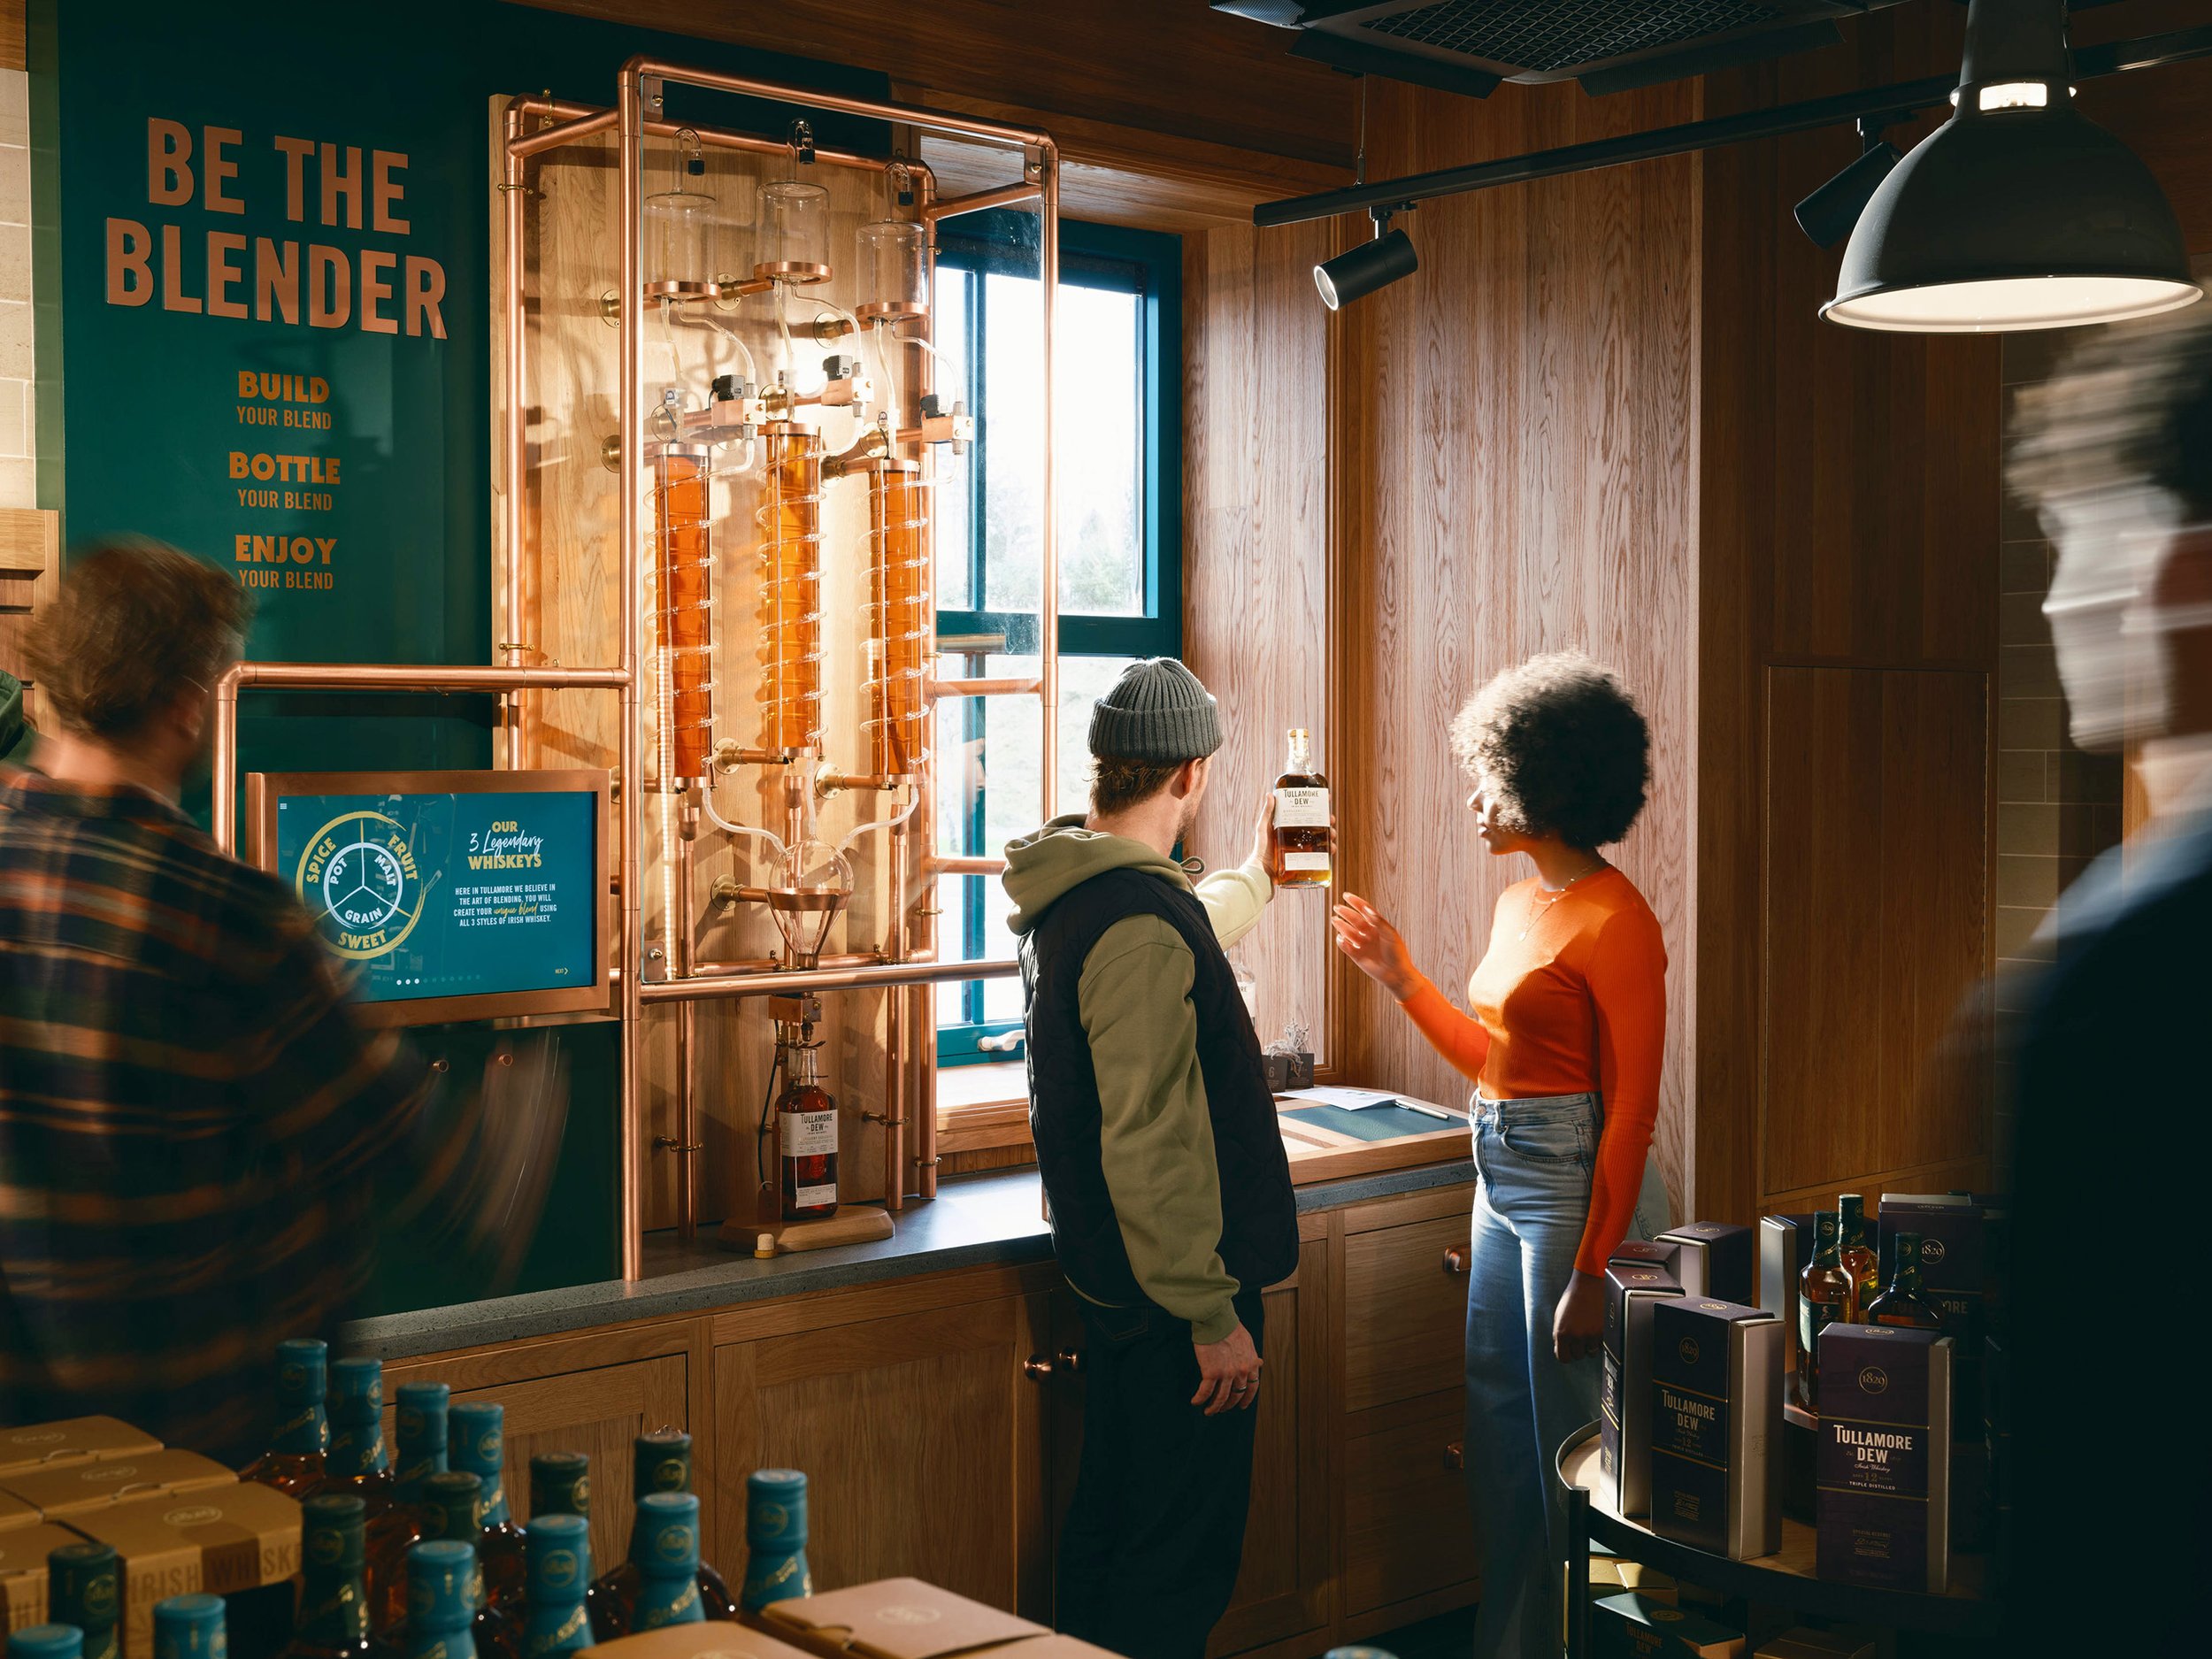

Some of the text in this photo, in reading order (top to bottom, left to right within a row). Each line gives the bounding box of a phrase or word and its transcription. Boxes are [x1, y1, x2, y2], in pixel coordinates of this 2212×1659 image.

[148, 117, 411, 235] BE THE
[106, 217, 448, 340] BLENDER
[238, 371, 330, 404] BUILD
[236, 405, 332, 430] YOUR BLEND
[228, 451, 341, 485] BOTTLE
[237, 488, 333, 511] YOUR BLEND
[234, 534, 338, 565] ENJOY
[238, 569, 334, 590] YOUR BLEND
[1284, 789, 1318, 798] TULLAMORE
[492, 820, 518, 833] OUR
[469, 829, 544, 857] 3 Legendary
[306, 837, 337, 884] SPICE
[388, 834, 419, 880] FRUIT
[468, 854, 541, 870] WHISKEYS
[330, 857, 348, 885] POT
[374, 854, 396, 887] MALT
[480, 886, 513, 895] TULLAMORE
[525, 884, 547, 893] BELIEVE
[549, 883, 556, 892] IN
[345, 907, 383, 924] GRAIN
[476, 907, 492, 916] YOUR
[476, 918, 497, 926] STYLES
[498, 917, 506, 926] OF
[507, 916, 524, 925] IRISH
[339, 929, 387, 949] SWEET
[801, 1113, 833, 1124] TULLAMORE
[1921, 1243, 1942, 1256] 1829
[1682, 1342, 1699, 1357] 1829
[1862, 1373, 1886, 1386] 1829
[1662, 1389, 1716, 1420] TULLAMORE
[1678, 1413, 1699, 1431] DEW
[1833, 1425, 1913, 1450] TULLAMORE
[1857, 1448, 1888, 1463] DEW
[130, 1563, 200, 1603] IRISH
